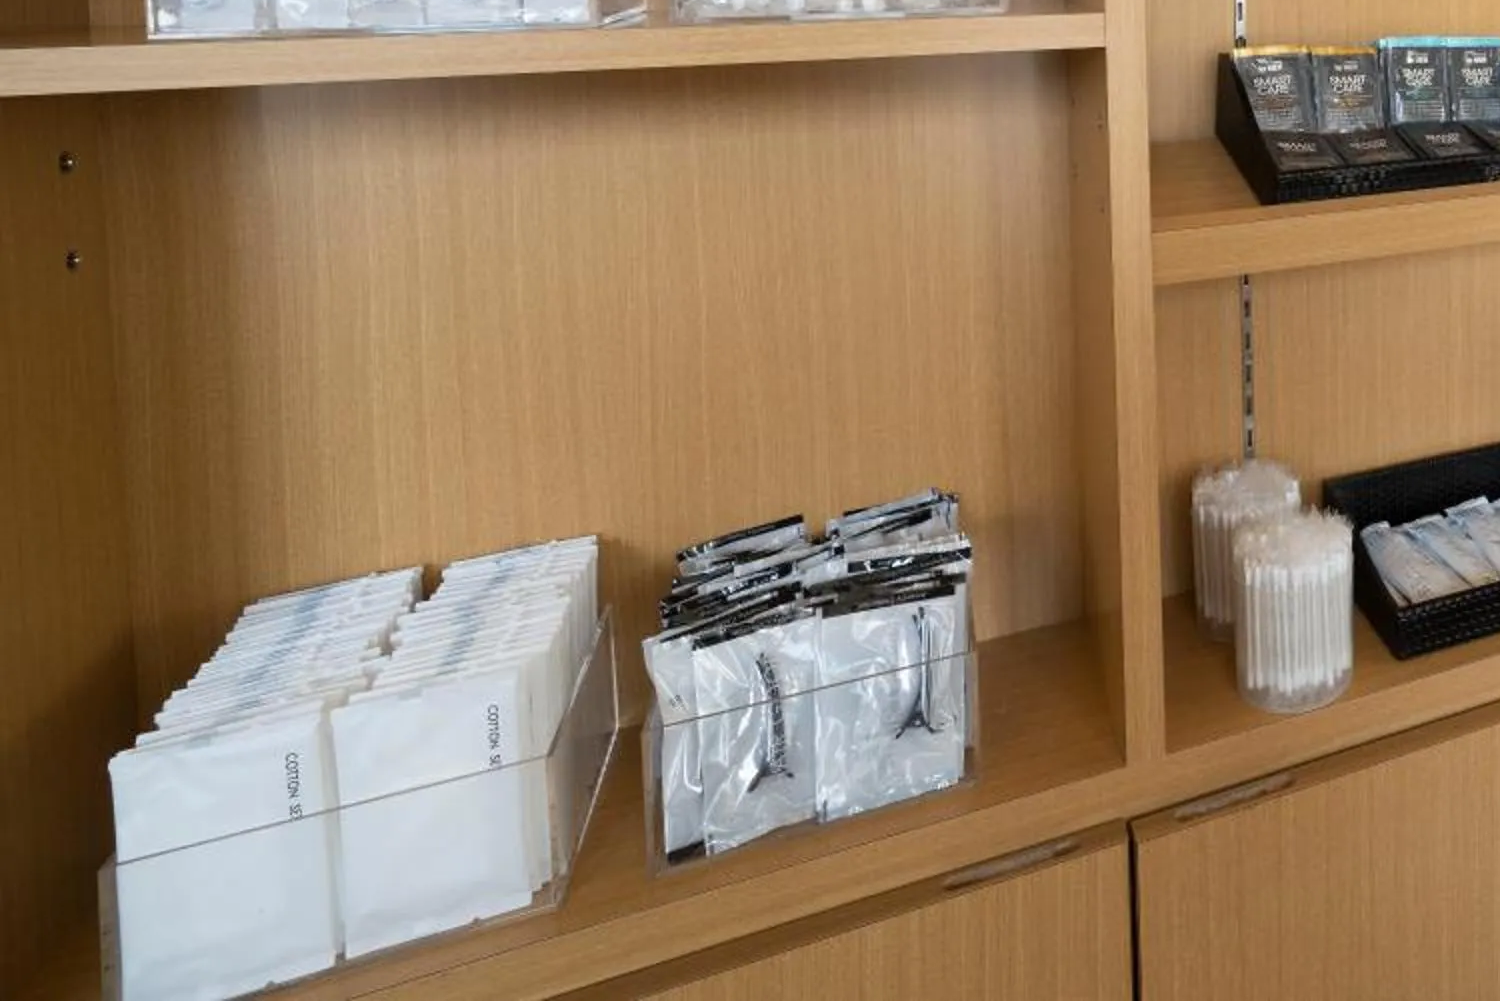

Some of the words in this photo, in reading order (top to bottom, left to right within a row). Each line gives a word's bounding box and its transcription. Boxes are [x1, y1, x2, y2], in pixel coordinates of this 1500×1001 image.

[1253, 75, 1292, 87] SMART
[487, 704, 500, 749] COTTON
[285, 752, 300, 799] COTTON
